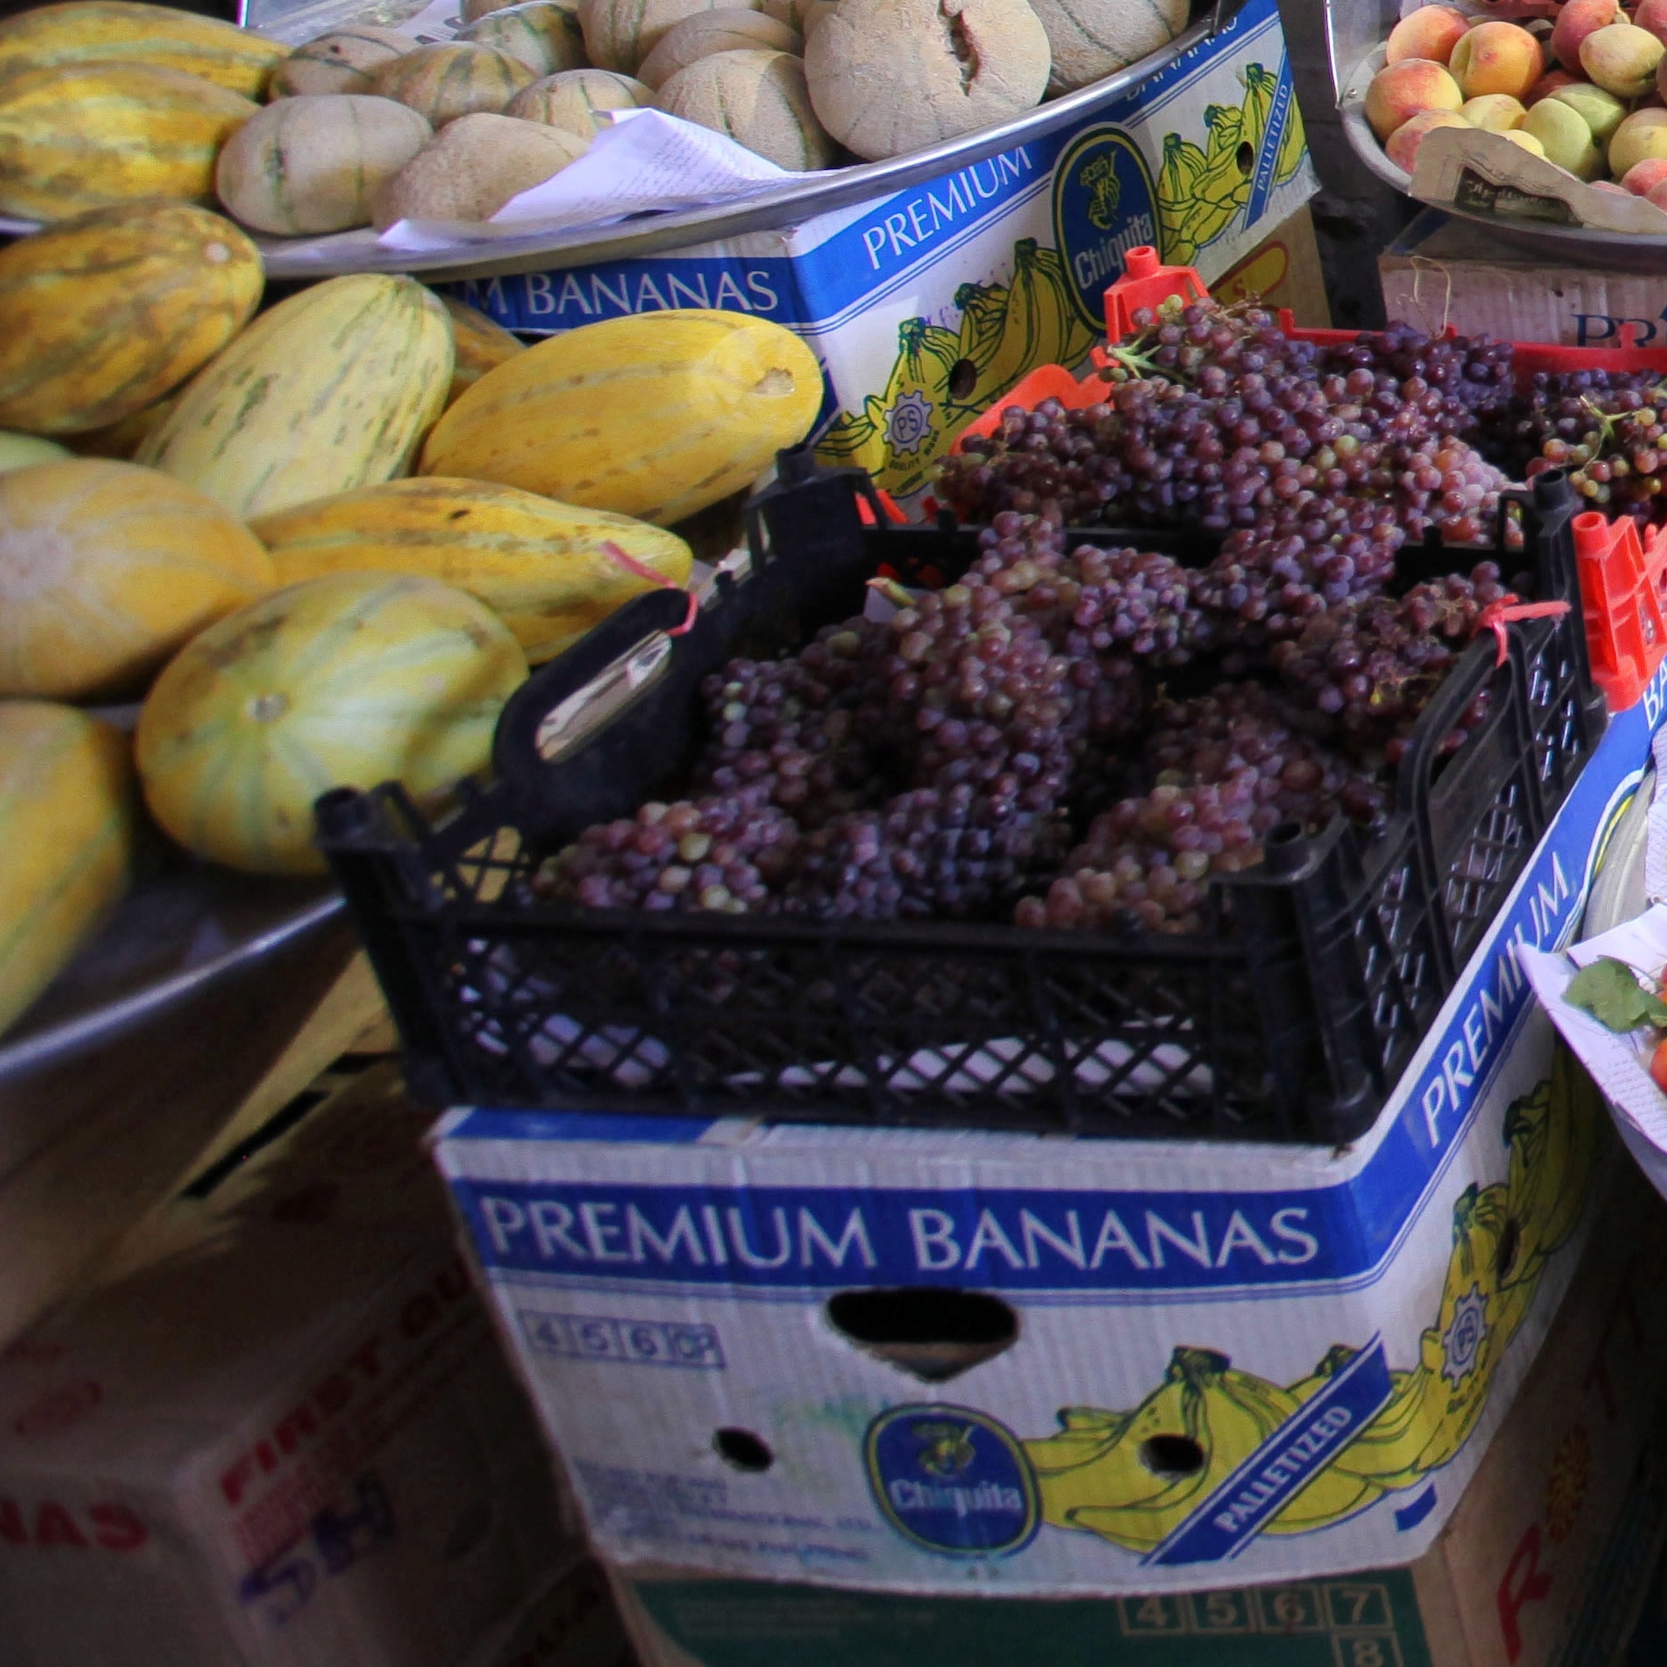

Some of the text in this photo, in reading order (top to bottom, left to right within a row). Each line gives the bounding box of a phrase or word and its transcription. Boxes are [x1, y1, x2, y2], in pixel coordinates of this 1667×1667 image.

[1256, 84, 1289, 193] PALLETIZED
[863, 145, 1035, 271] PREMIUM
[1073, 212, 1153, 291] Chiquita
[525, 270, 780, 315] BANANAS
[481, 1196, 1320, 1272] PREMIUM BANANAS
[582, 1321, 610, 1351] 5
[630, 1326, 659, 1357] 6
[889, 1478, 1024, 1520] Chiquita
[1211, 1404, 1354, 1536] PALLETIZED
[1136, 1589, 1372, 1627] 4 5 6 7
[1352, 1639, 1385, 1667] 8
